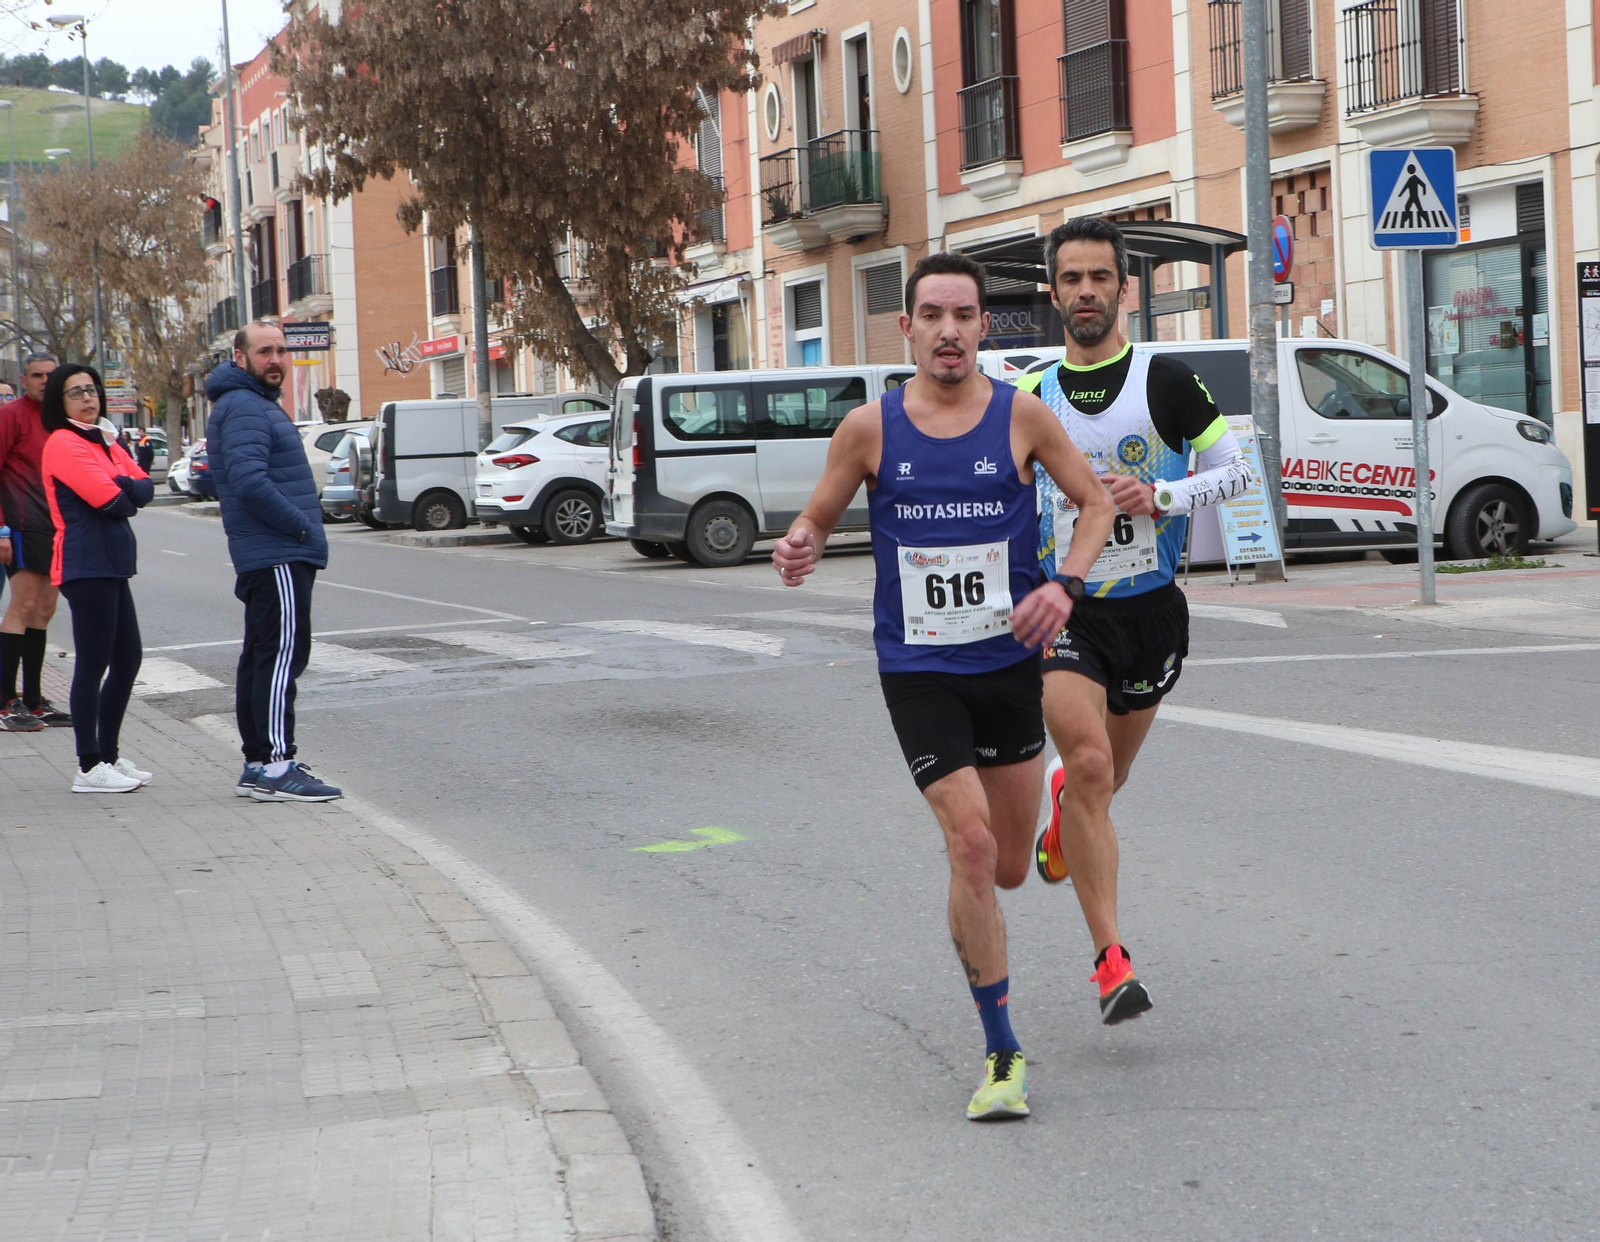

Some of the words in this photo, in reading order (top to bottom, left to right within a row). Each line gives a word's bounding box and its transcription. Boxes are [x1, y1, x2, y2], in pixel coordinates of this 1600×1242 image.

[1069, 389, 1106, 400] land
[894, 500, 1005, 519] TROTASIERRA
[925, 571, 985, 609] 616
[947, 607, 972, 615] MONTERO
